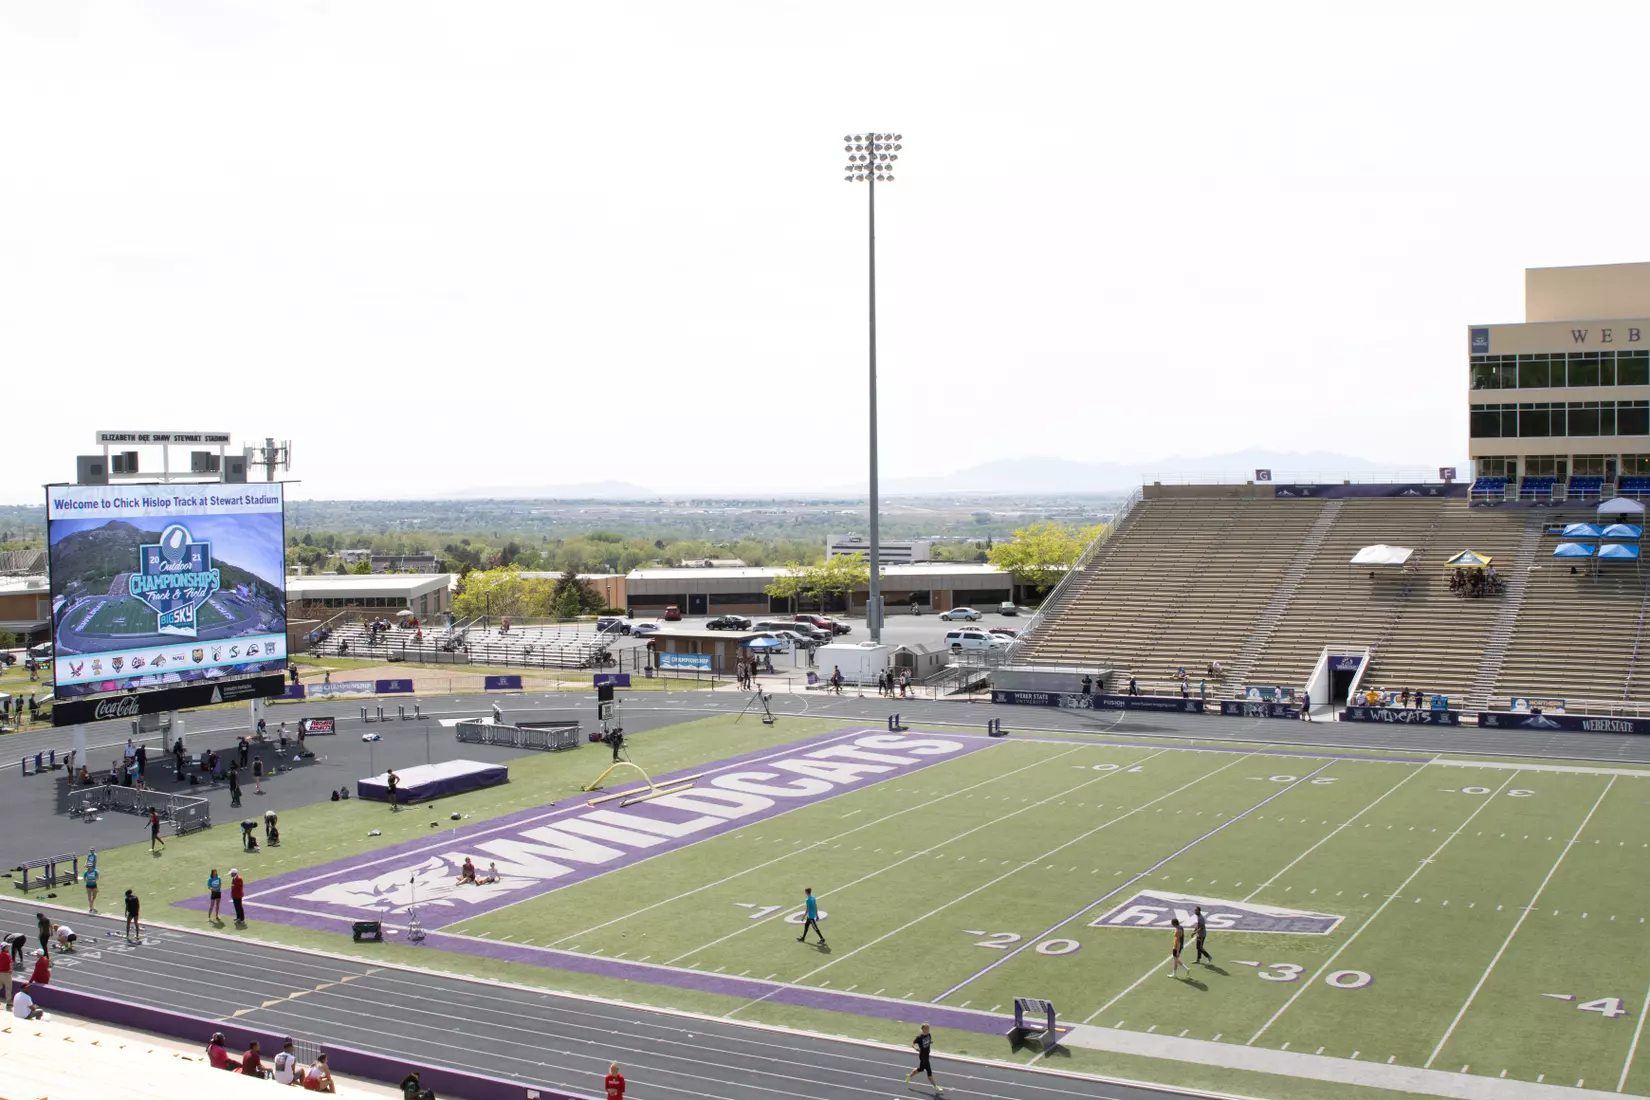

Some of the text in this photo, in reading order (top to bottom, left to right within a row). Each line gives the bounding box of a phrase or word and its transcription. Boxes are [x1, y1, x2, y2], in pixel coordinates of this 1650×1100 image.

[1259, 471, 1268, 480] G
[1444, 469, 1451, 478] F
[54, 495, 279, 510] Welcome to Chick Hislop Track at Stewart Stadium
[149, 553, 202, 564] 20 21
[159, 560, 193, 572] Outdoor
[131, 570, 218, 594] CHAMPIONSHIPS
[146, 587, 208, 601] Track & Field
[323, 683, 372, 691] CHAMPIONSHIP
[94, 695, 140, 720] Coca-Cola
[1370, 709, 1432, 723] WILDCATS
[1582, 719, 1634, 733] WEBER STATE
[440, 731, 965, 880] WILDCATS
